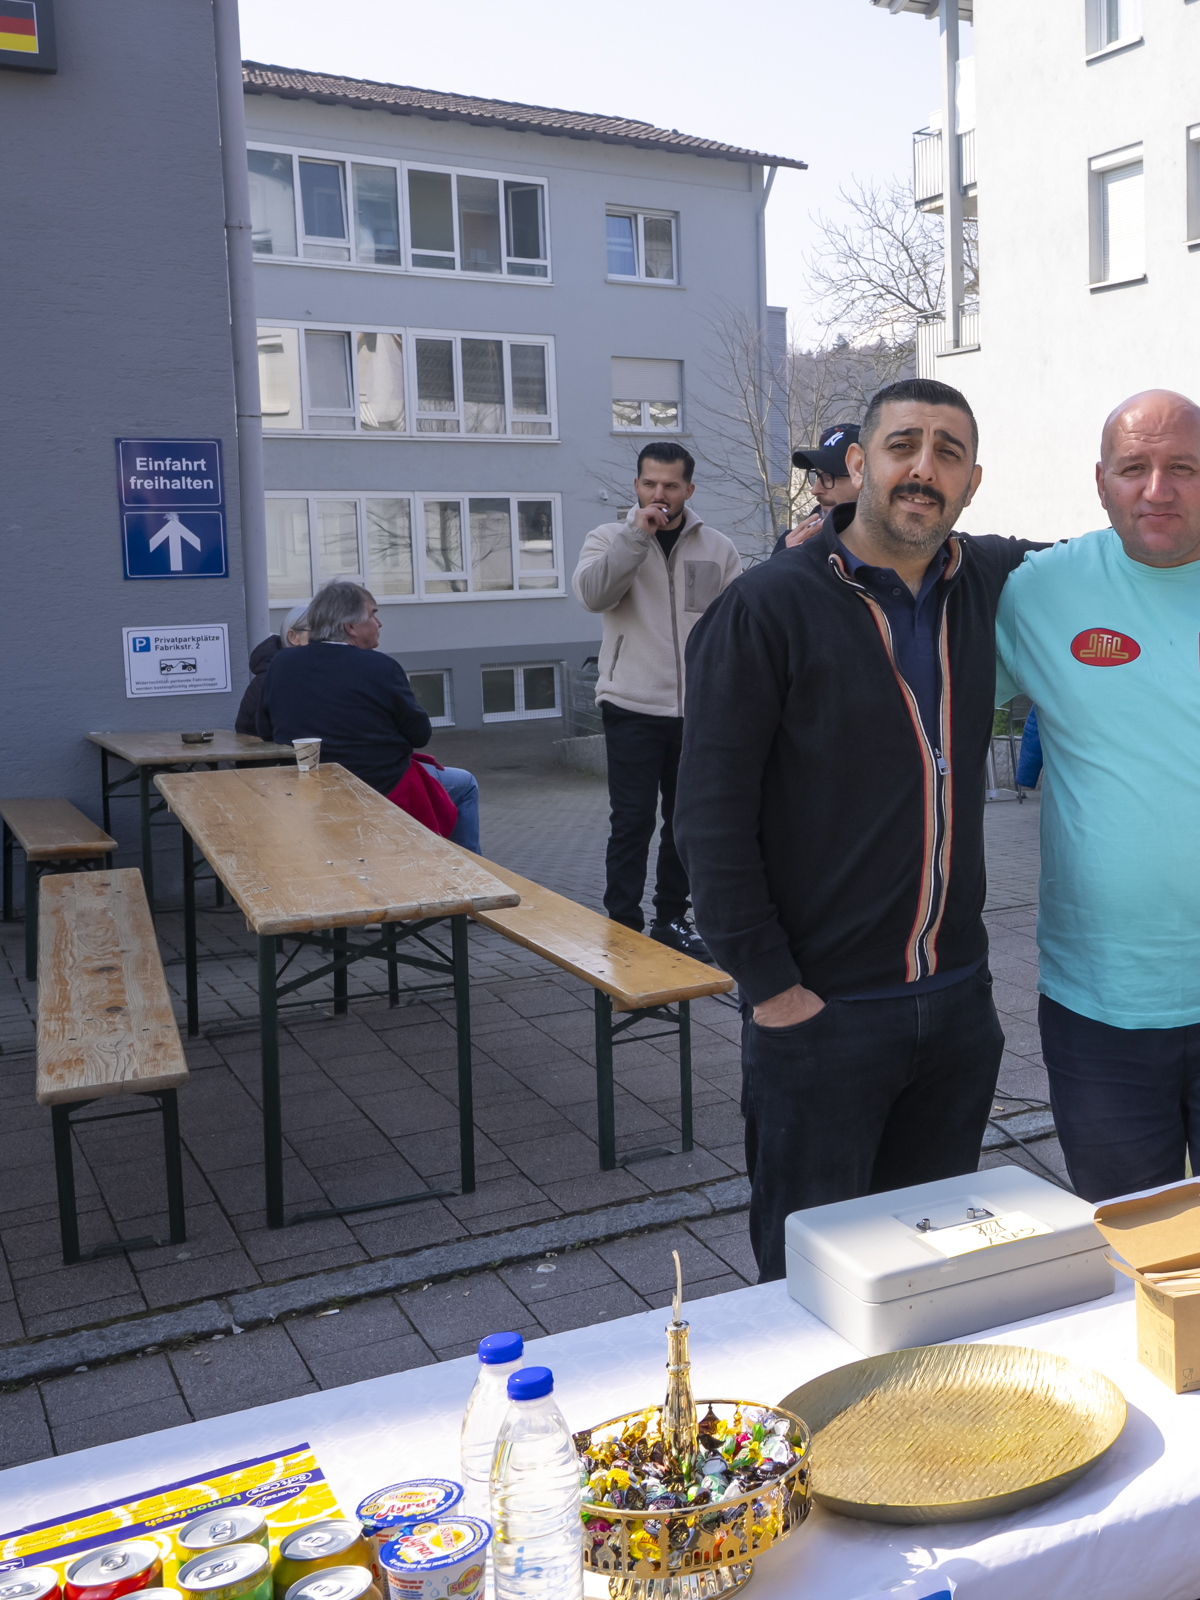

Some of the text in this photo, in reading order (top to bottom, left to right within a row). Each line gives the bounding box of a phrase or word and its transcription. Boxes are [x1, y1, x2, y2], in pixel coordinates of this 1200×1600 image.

[136, 457, 207, 471] Einfahrt
[129, 476, 214, 490] freihalten
[154, 635, 220, 644] Privatparkplätze
[249, 1473, 307, 1496] Soft Care
[260, 1486, 301, 1503] Diversey
[144, 1493, 242, 1528] Lemonfresh
[374, 1498, 437, 1519] Ayran
